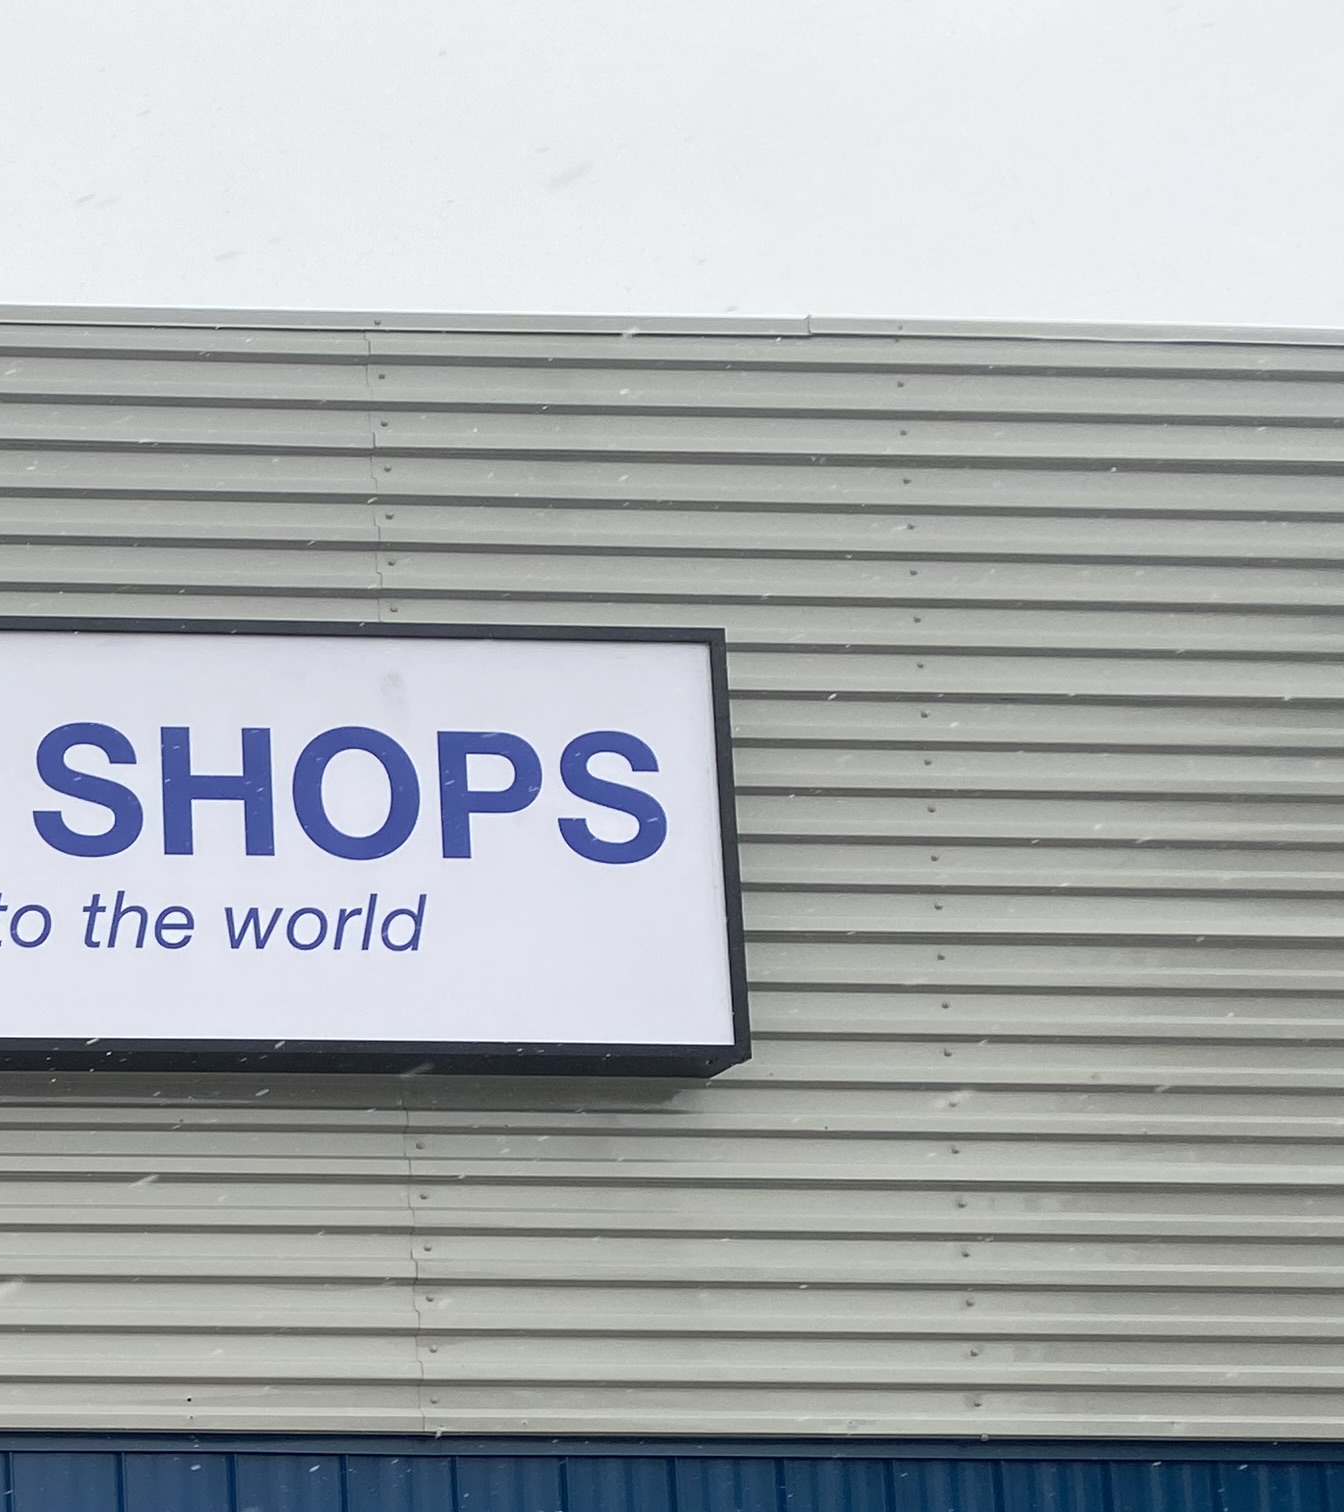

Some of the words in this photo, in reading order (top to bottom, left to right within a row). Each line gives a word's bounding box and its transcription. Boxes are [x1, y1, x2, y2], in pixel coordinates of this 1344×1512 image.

[32, 721, 668, 865] SHOPS
[84, 891, 195, 949] the
[224, 893, 427, 952] world
